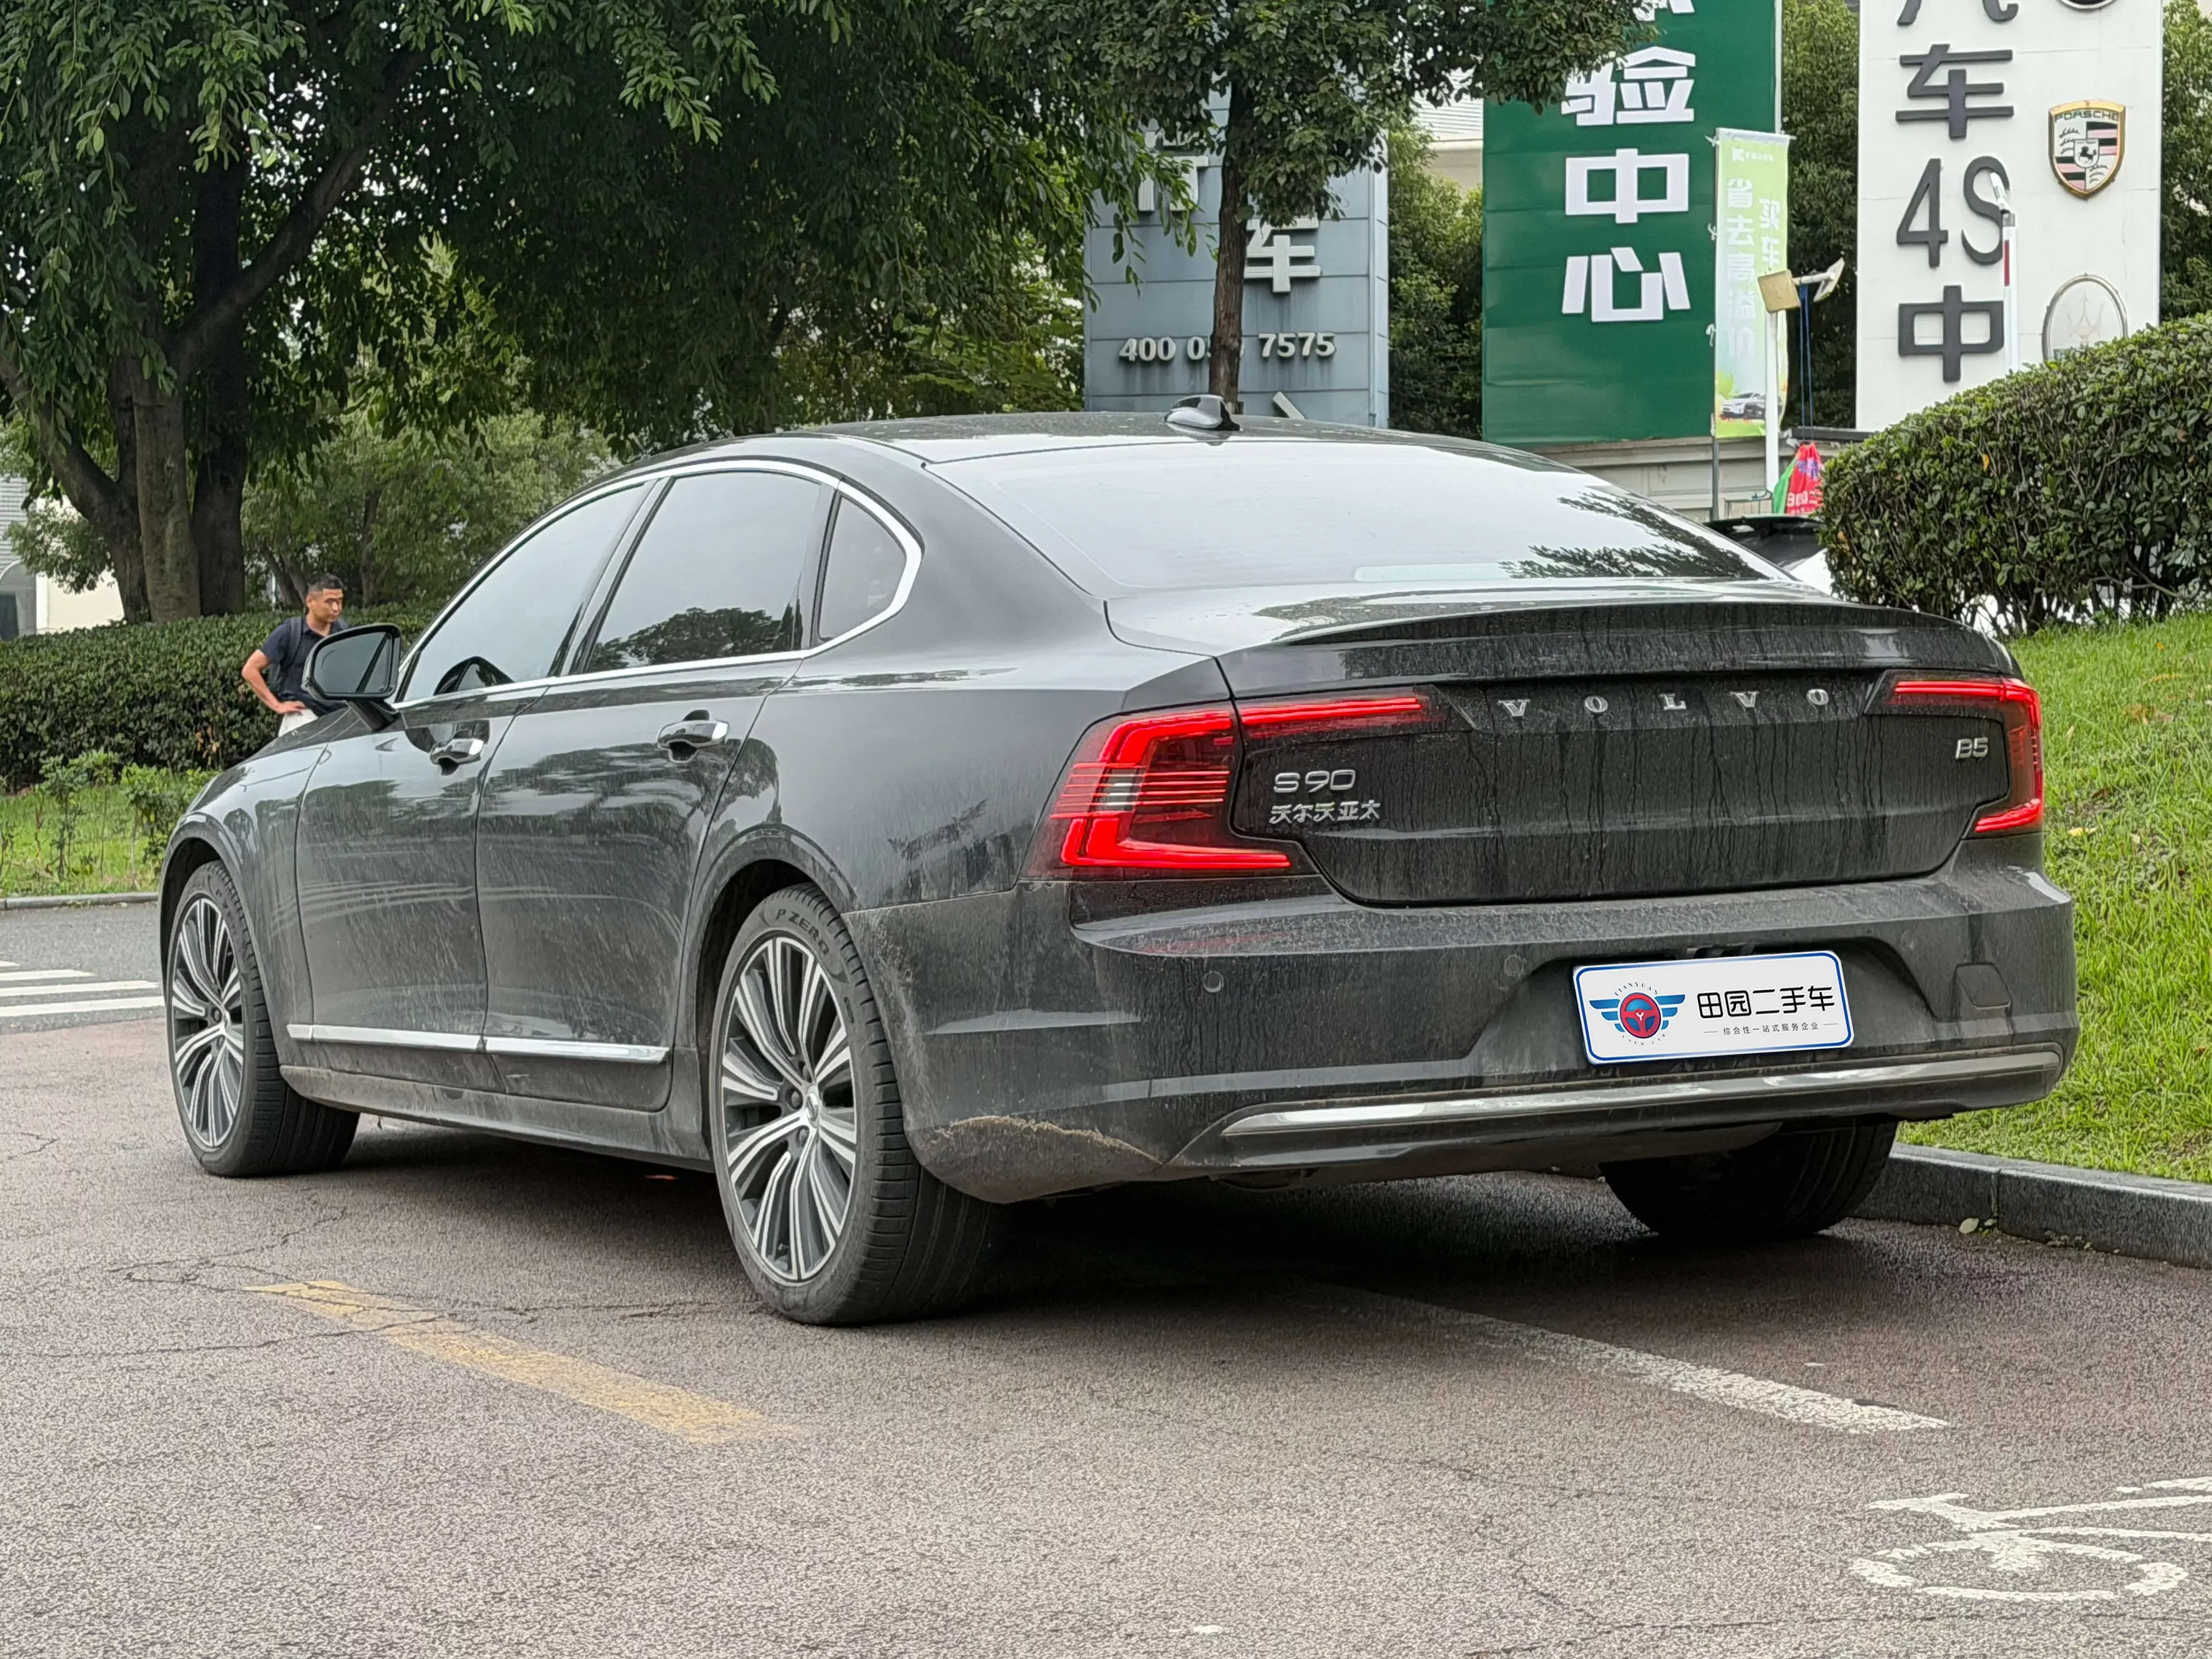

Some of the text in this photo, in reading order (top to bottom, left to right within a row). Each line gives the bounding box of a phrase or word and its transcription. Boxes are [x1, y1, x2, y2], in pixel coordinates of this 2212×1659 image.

[1561, 0, 1696, 322] 验中心
[1895, 0, 2019, 382] 车4S中
[1119, 337, 1176, 362] 400
[1258, 332, 1336, 358] 7575
[1498, 689, 1829, 716] VOLVO
[1955, 737, 1988, 759] B5
[1273, 769, 1356, 793] S90
[1269, 799, 1381, 824] 沃尔沃亚太
[788, 910, 830, 955] ZERO
